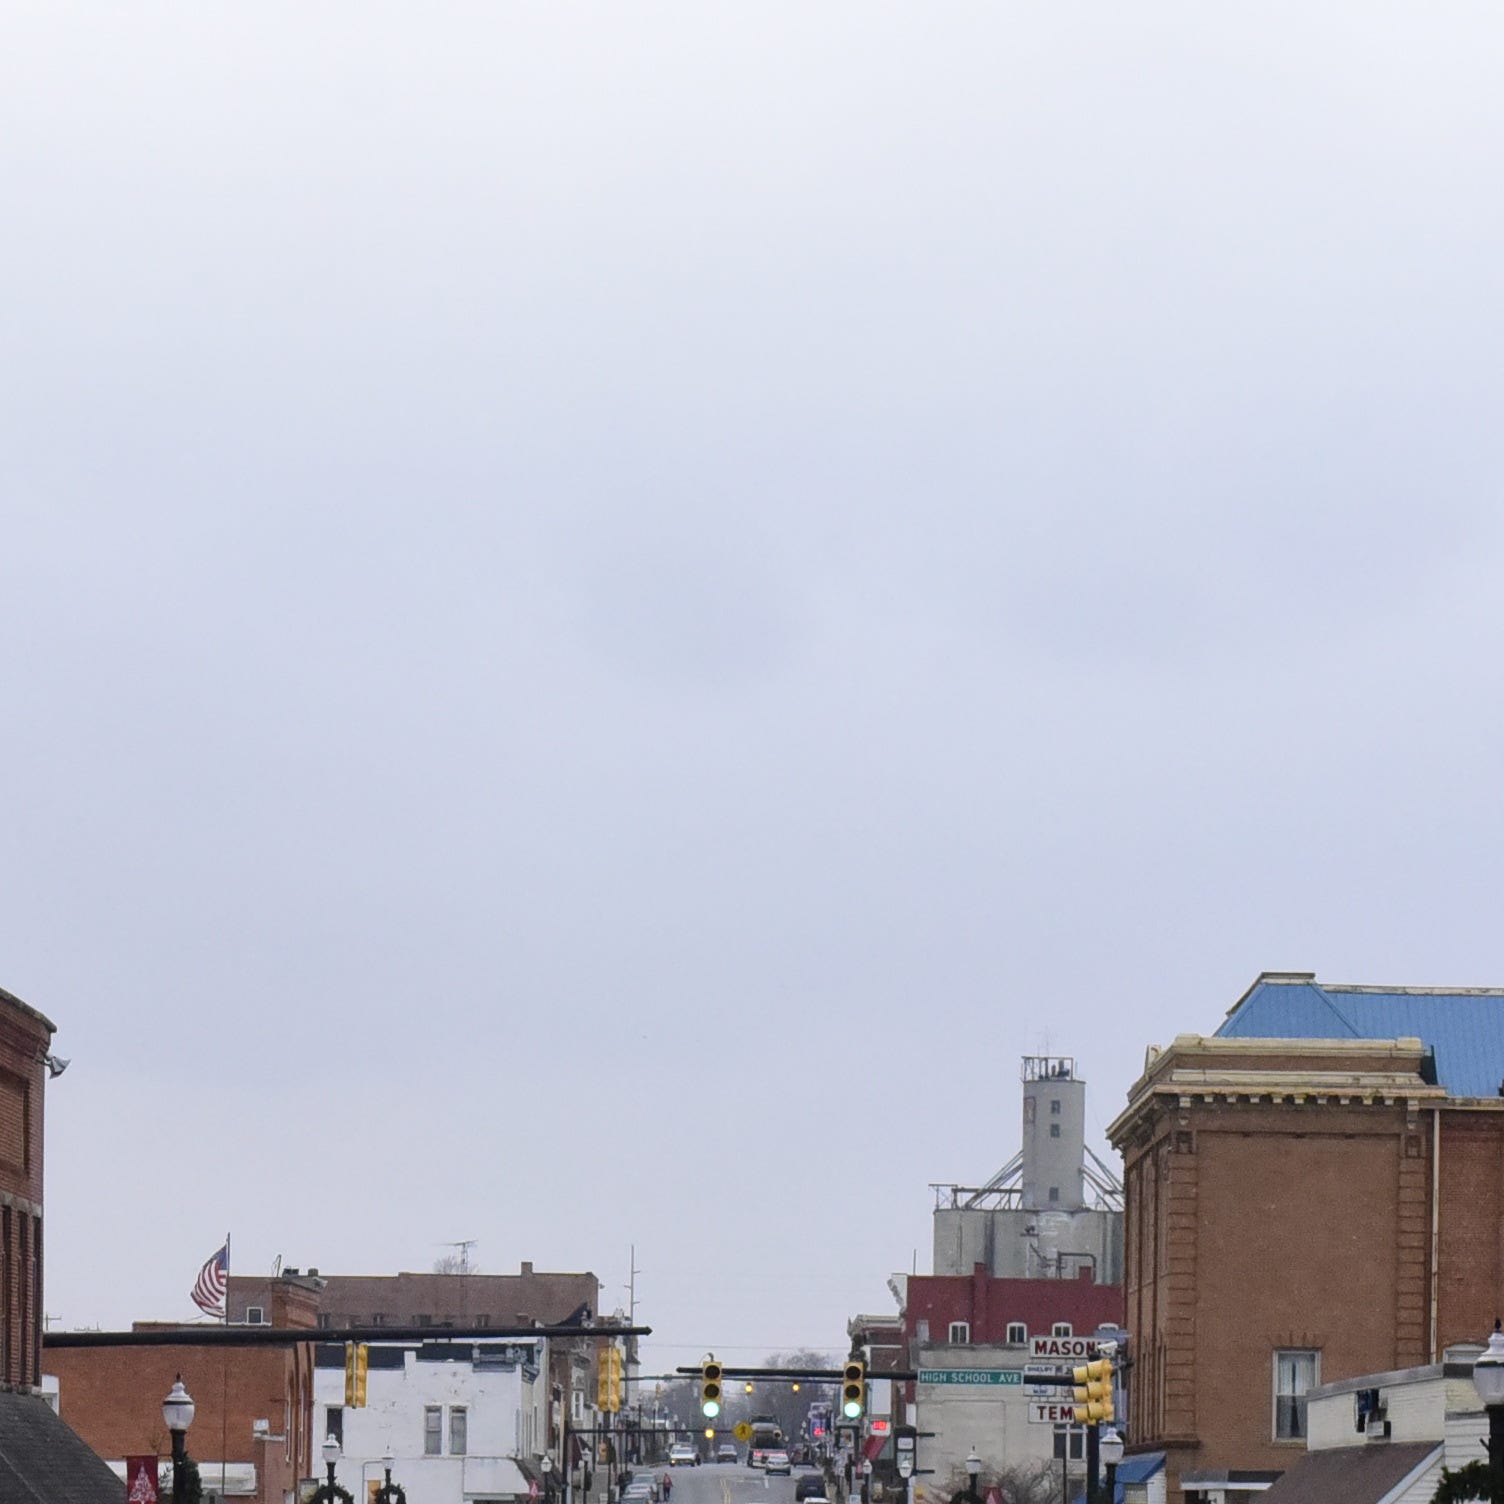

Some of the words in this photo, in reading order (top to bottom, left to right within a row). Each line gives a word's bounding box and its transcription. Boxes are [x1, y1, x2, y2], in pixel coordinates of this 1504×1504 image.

[1035, 1340, 1112, 1356] MASON
[921, 1373, 947, 1382] HIGH
[952, 1373, 992, 1383] SCHOOL
[999, 1374, 1020, 1383] AVE
[1037, 1405, 1073, 1420] TEM
